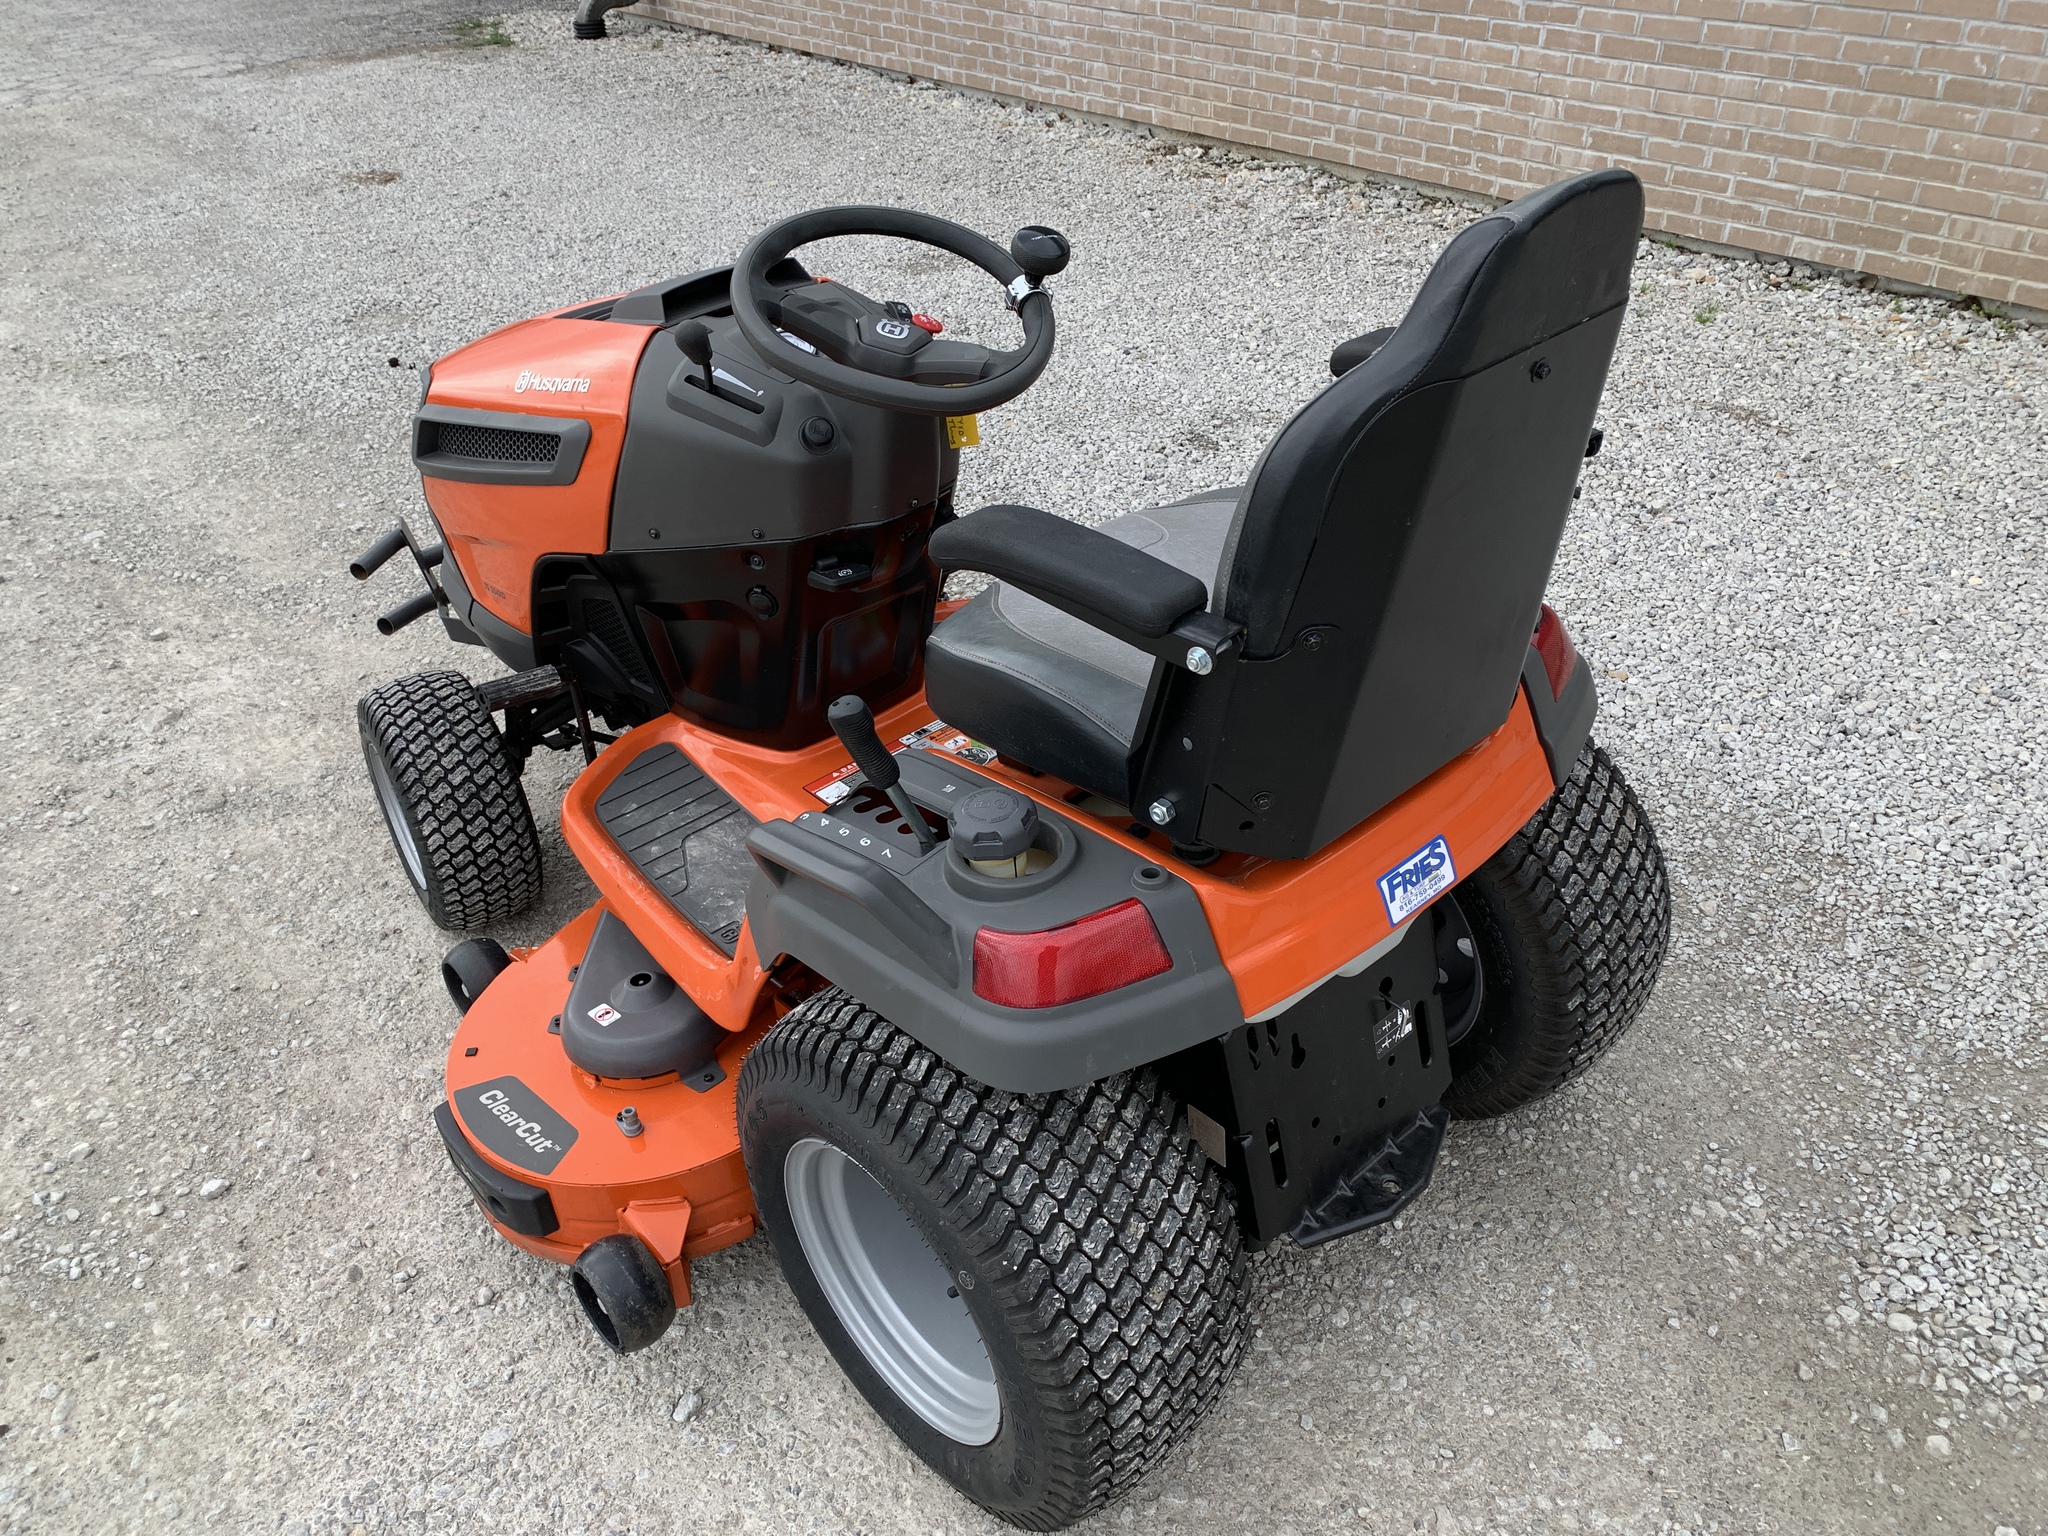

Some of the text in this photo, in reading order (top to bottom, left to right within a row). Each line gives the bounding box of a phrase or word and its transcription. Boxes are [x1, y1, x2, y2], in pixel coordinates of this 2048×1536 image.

[527, 373, 591, 395] Husqvarna
[820, 818, 830, 827] 4
[838, 827, 850, 837] 5
[860, 837, 871, 847] 6
[881, 848, 892, 859] 7
[1386, 841, 1446, 904] FRIES
[1398, 874, 1446, 912] 816-759-0499
[478, 1089, 554, 1153] ClearCut
